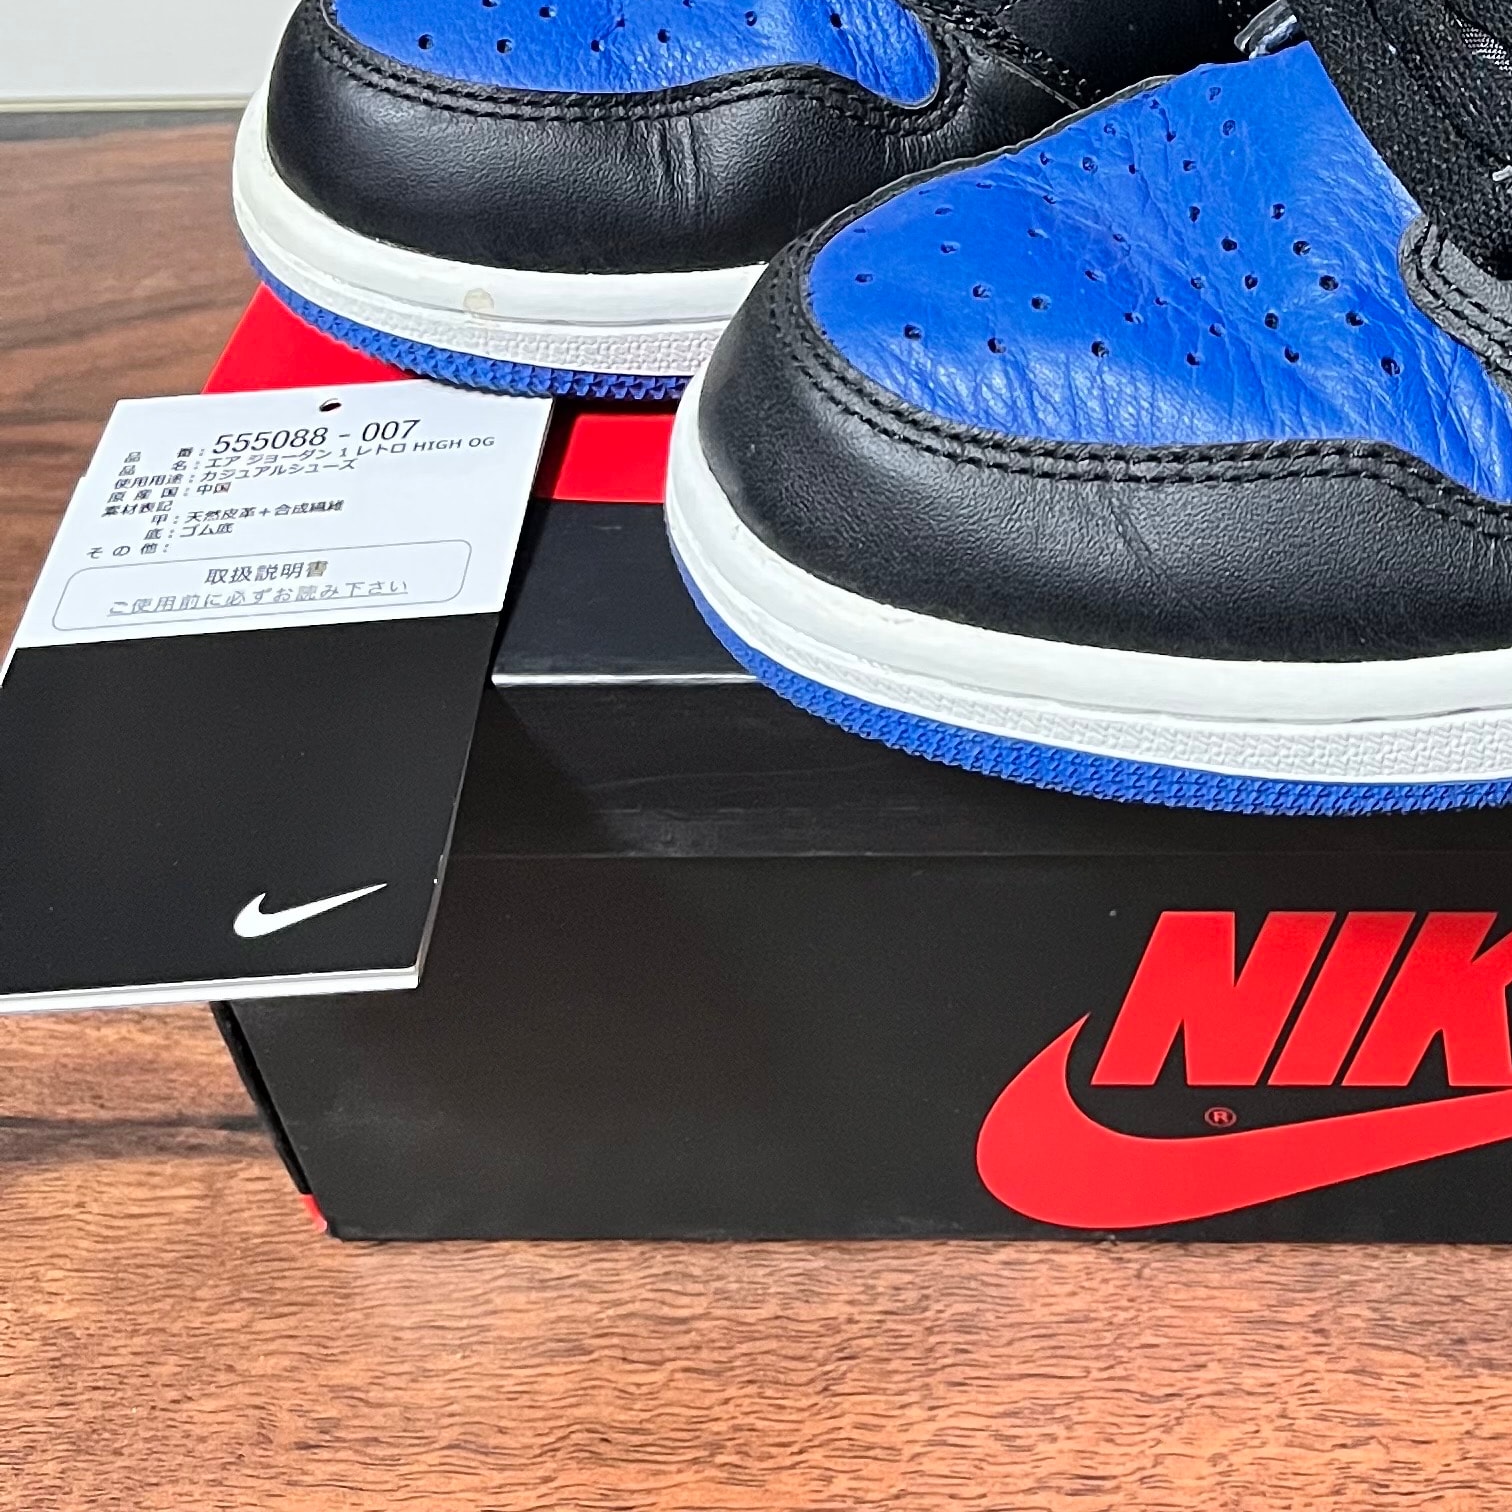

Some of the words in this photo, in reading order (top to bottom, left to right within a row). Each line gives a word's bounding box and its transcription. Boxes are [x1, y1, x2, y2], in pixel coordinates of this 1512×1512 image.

[413, 438, 461, 451] HIGH
[468, 437, 495, 448] OG
[204, 560, 329, 584] 取扱説明書
